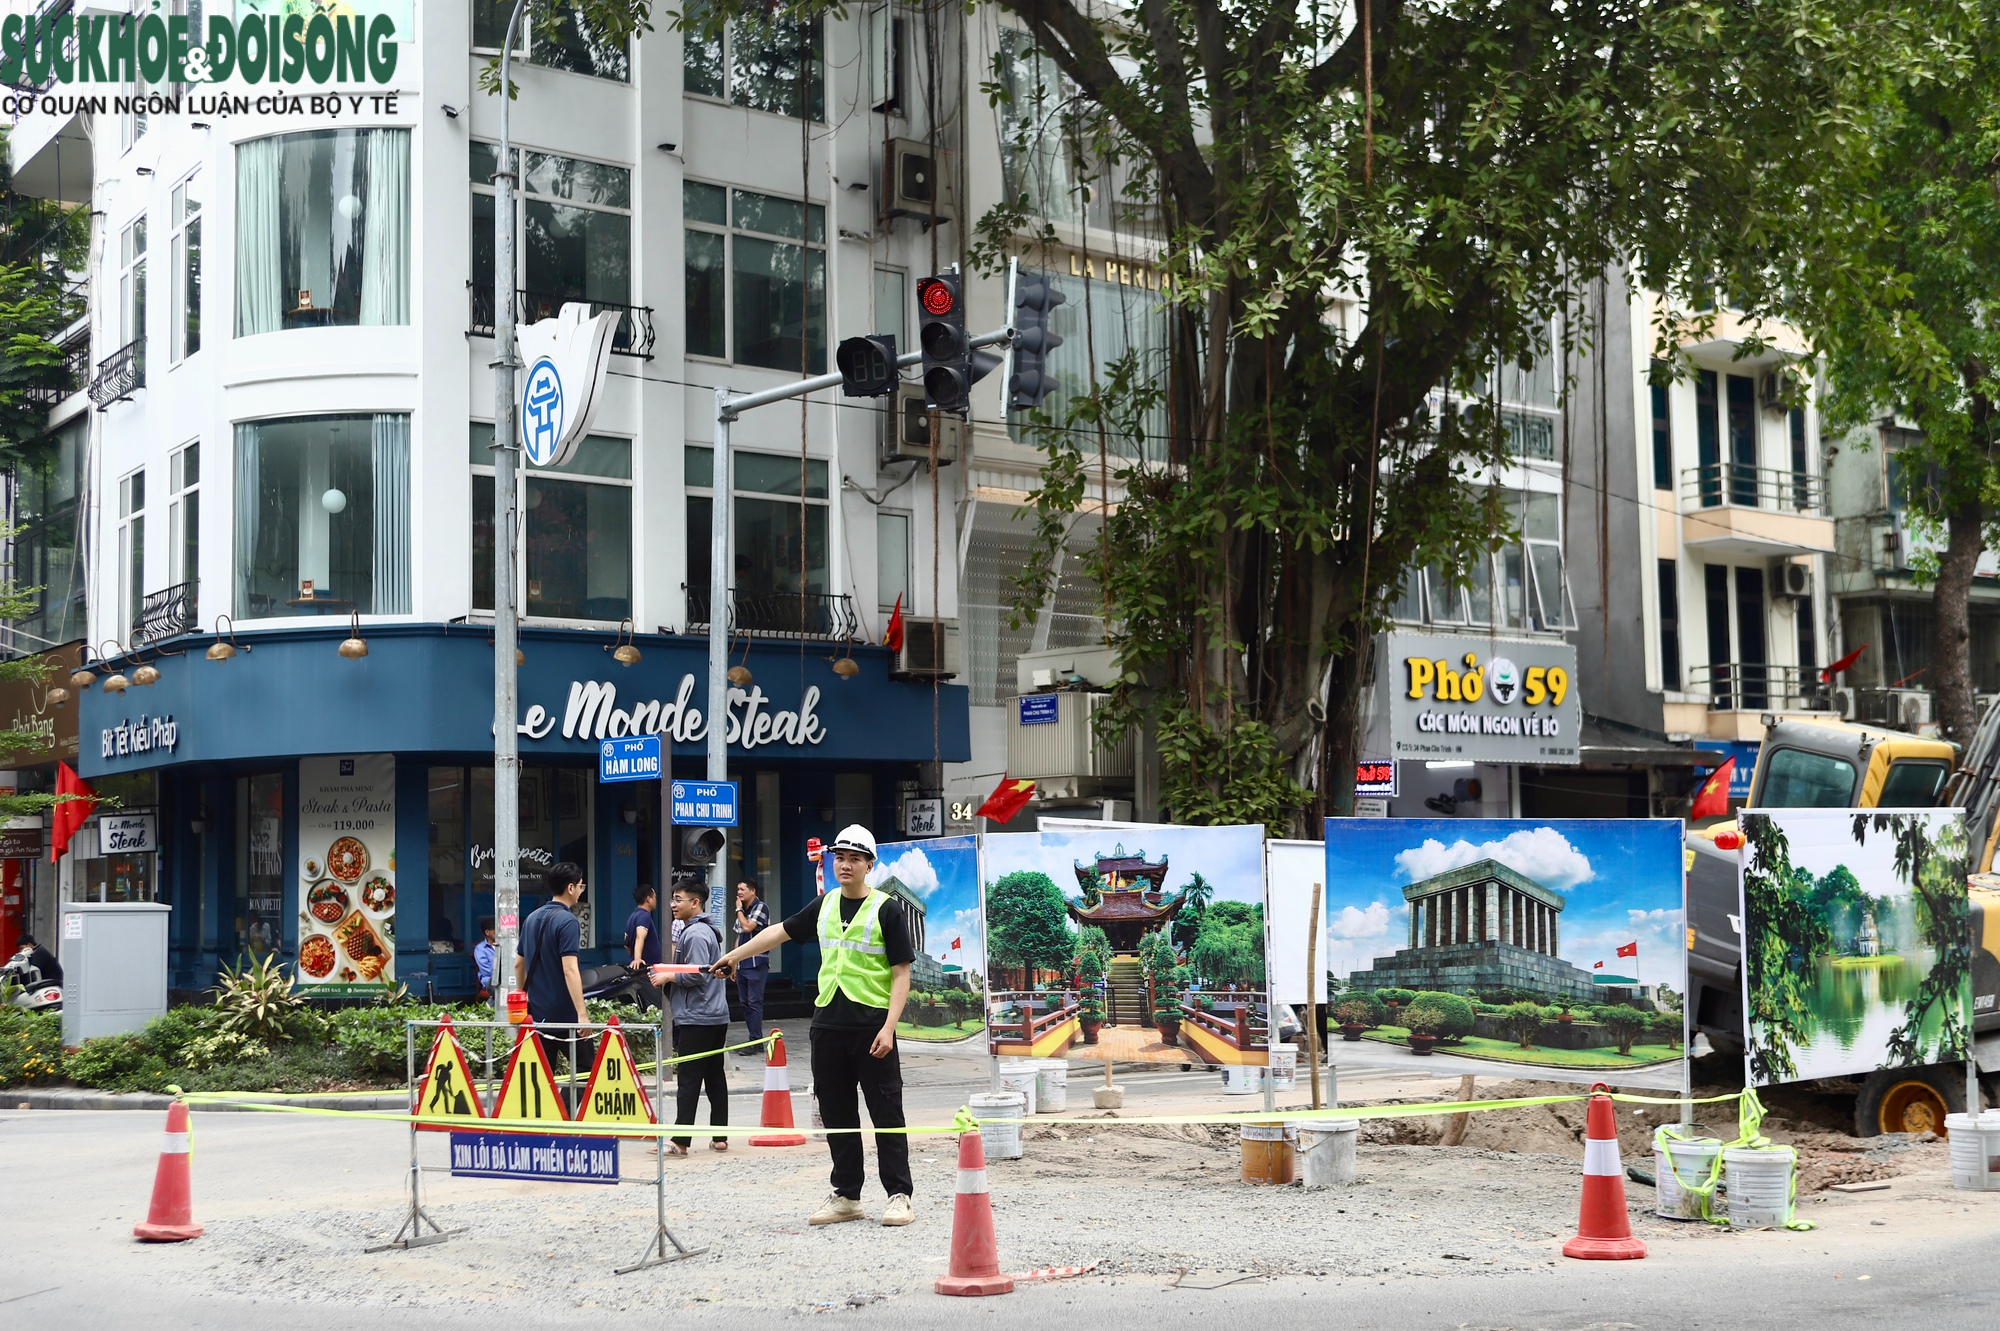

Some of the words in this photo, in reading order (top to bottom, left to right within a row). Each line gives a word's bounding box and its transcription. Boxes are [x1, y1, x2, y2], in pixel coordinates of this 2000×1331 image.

[1070, 254, 1095, 279] LA
[1407, 652, 1485, 702] Phở
[1525, 665, 1568, 706] 59
[562, 673, 710, 743] Monde
[726, 685, 826, 750] Steak
[1418, 709, 1444, 732] CÁC
[1448, 710, 1480, 733] MÓN
[1482, 712, 1519, 735] NGON
[1542, 715, 1559, 736] BÒ
[114, 719, 128, 756] Tết
[130, 714, 151, 753] Kiểu
[152, 714, 177, 754] Pháp
[624, 739, 644, 752] PHỐ
[605, 756, 629, 775] HÀM
[631, 756, 658, 773] LONG
[1377, 766, 1391, 781] 59
[696, 785, 717, 797] PHỐ
[302, 797, 339, 815] Steak
[342, 805, 349, 814] &
[352, 796, 392, 813] Pasta
[675, 802, 694, 817] PHAN
[696, 803, 710, 818] CHU
[712, 803, 733, 819] TRINH
[911, 803, 919, 814] Le
[919, 801, 936, 813] Monde
[951, 802, 973, 820] 34
[109, 821, 119, 830] Le
[120, 817, 148, 830] Monde
[911, 813, 936, 834] Steak
[109, 829, 149, 850] Steak
[470, 844, 497, 869] Bon
[530, 871, 542, 880] here
[607, 1058, 621, 1081] ĐI
[595, 1087, 636, 1121] CHẬM
[454, 1144, 472, 1169] XIN
[473, 1137, 490, 1170] LỖI
[492, 1141, 507, 1170] ĐÃ
[508, 1141, 531, 1172] LÀM
[533, 1140, 565, 1173] PHIỀN
[567, 1144, 588, 1174] CÁC
[591, 1150, 613, 1179] BẠN
